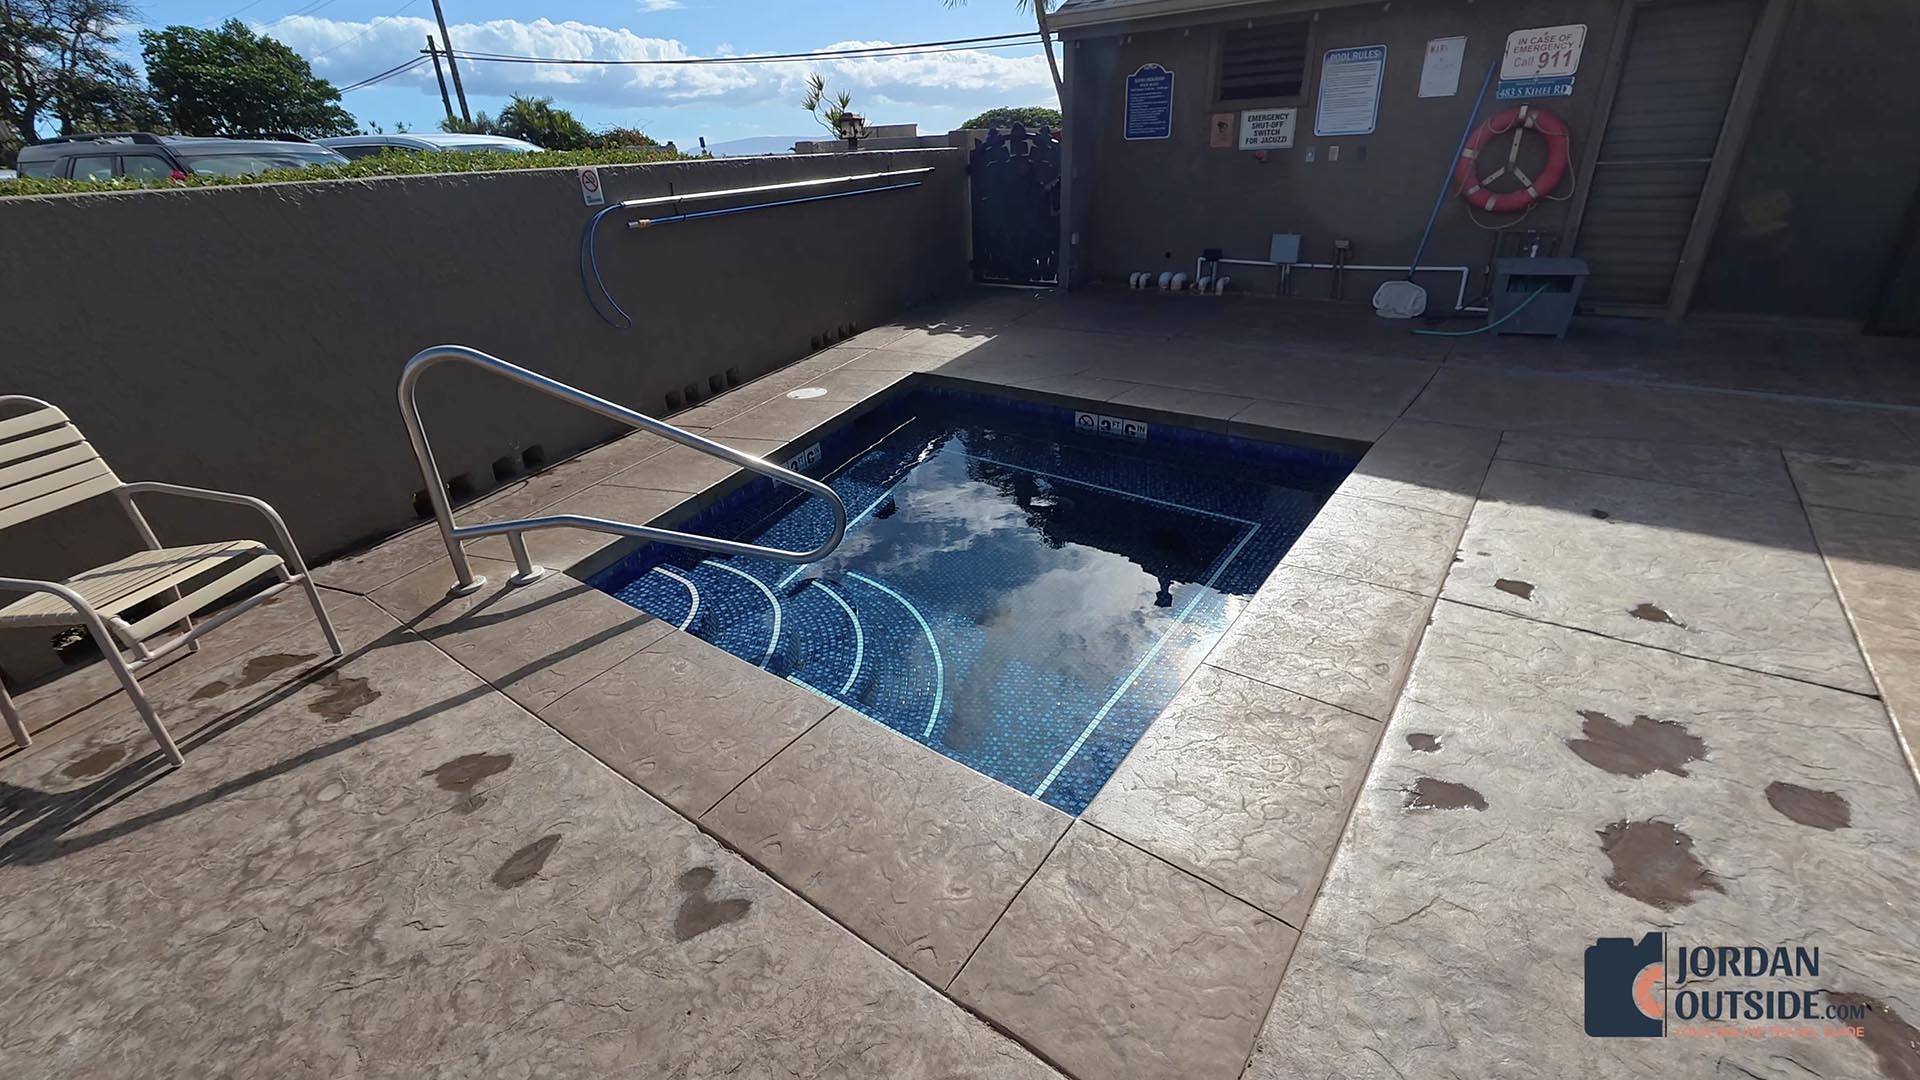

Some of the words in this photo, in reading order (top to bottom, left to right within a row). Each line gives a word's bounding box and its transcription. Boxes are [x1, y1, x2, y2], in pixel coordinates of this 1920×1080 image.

[1530, 35, 1557, 45] CASE
[1558, 33, 1573, 42] OF
[1513, 42, 1574, 53] EMERGENCY
[1352, 49, 1380, 61] RULES
[1513, 56, 1535, 67] Call
[1538, 50, 1573, 68] 911
[1247, 113, 1289, 122] EMERGENCY
[1251, 121, 1284, 129] SHUT-OFF
[1260, 136, 1288, 144] JACUZZI
